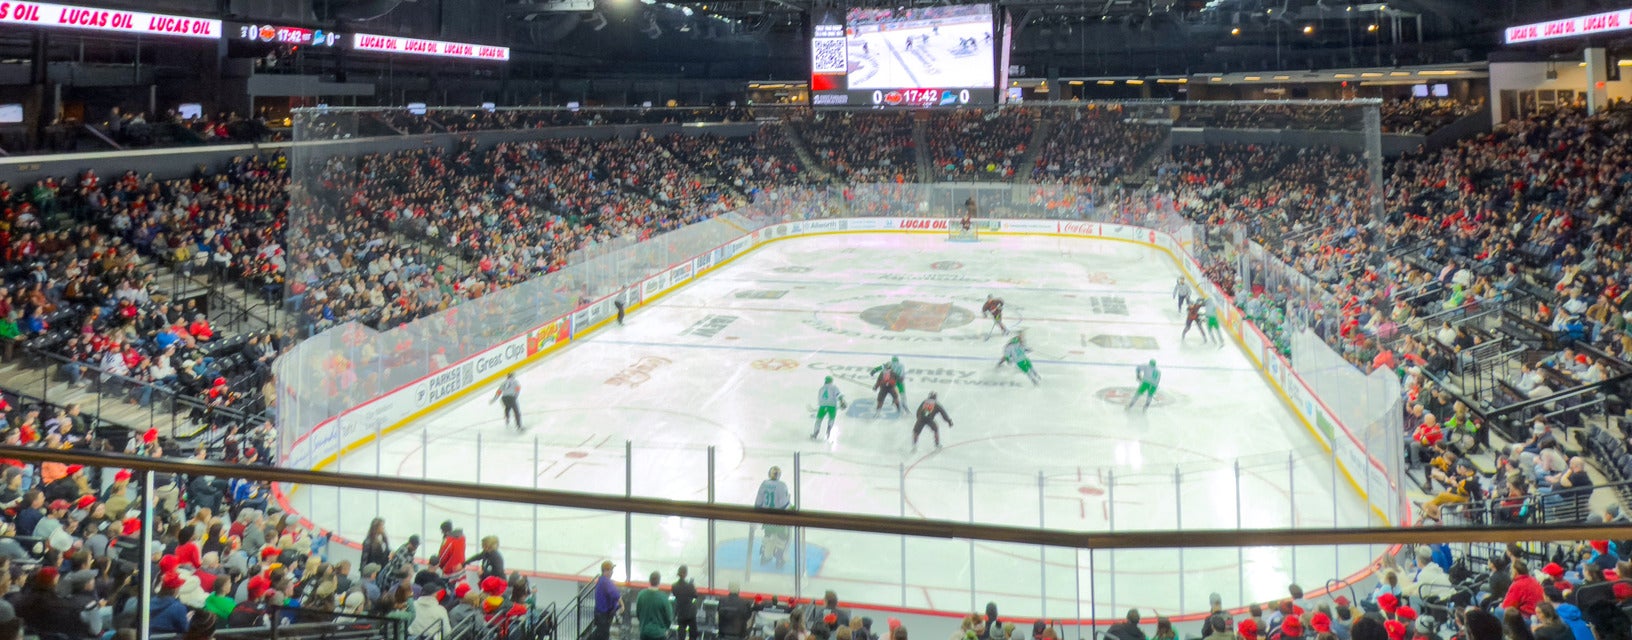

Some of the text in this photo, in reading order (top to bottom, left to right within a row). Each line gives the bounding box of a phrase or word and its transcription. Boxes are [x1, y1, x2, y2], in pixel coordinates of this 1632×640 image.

[13, 5, 39, 21] OIL
[58, 8, 133, 29] LUCAS OIL
[149, 17, 211, 35] LUCAS OIL
[1544, 21, 1576, 36] LUCAS OIL
[1583, 16, 1606, 31] LUCAS
[1608, 14, 1620, 28] OIL
[277, 28, 302, 42] 17:42
[1511, 26, 1538, 41] LUCAS OIL
[360, 36, 397, 50] LUCAS OIL
[404, 40, 437, 53] LUCAS OIL
[444, 44, 472, 56] LUCAS OIL
[479, 47, 505, 58] LUCAS OIL
[873, 89, 969, 104] 0 17:42 0
[900, 219, 929, 229] LUCAS
[932, 220, 948, 229] OIL
[476, 353, 502, 373] Great
[505, 344, 525, 360] Clips
